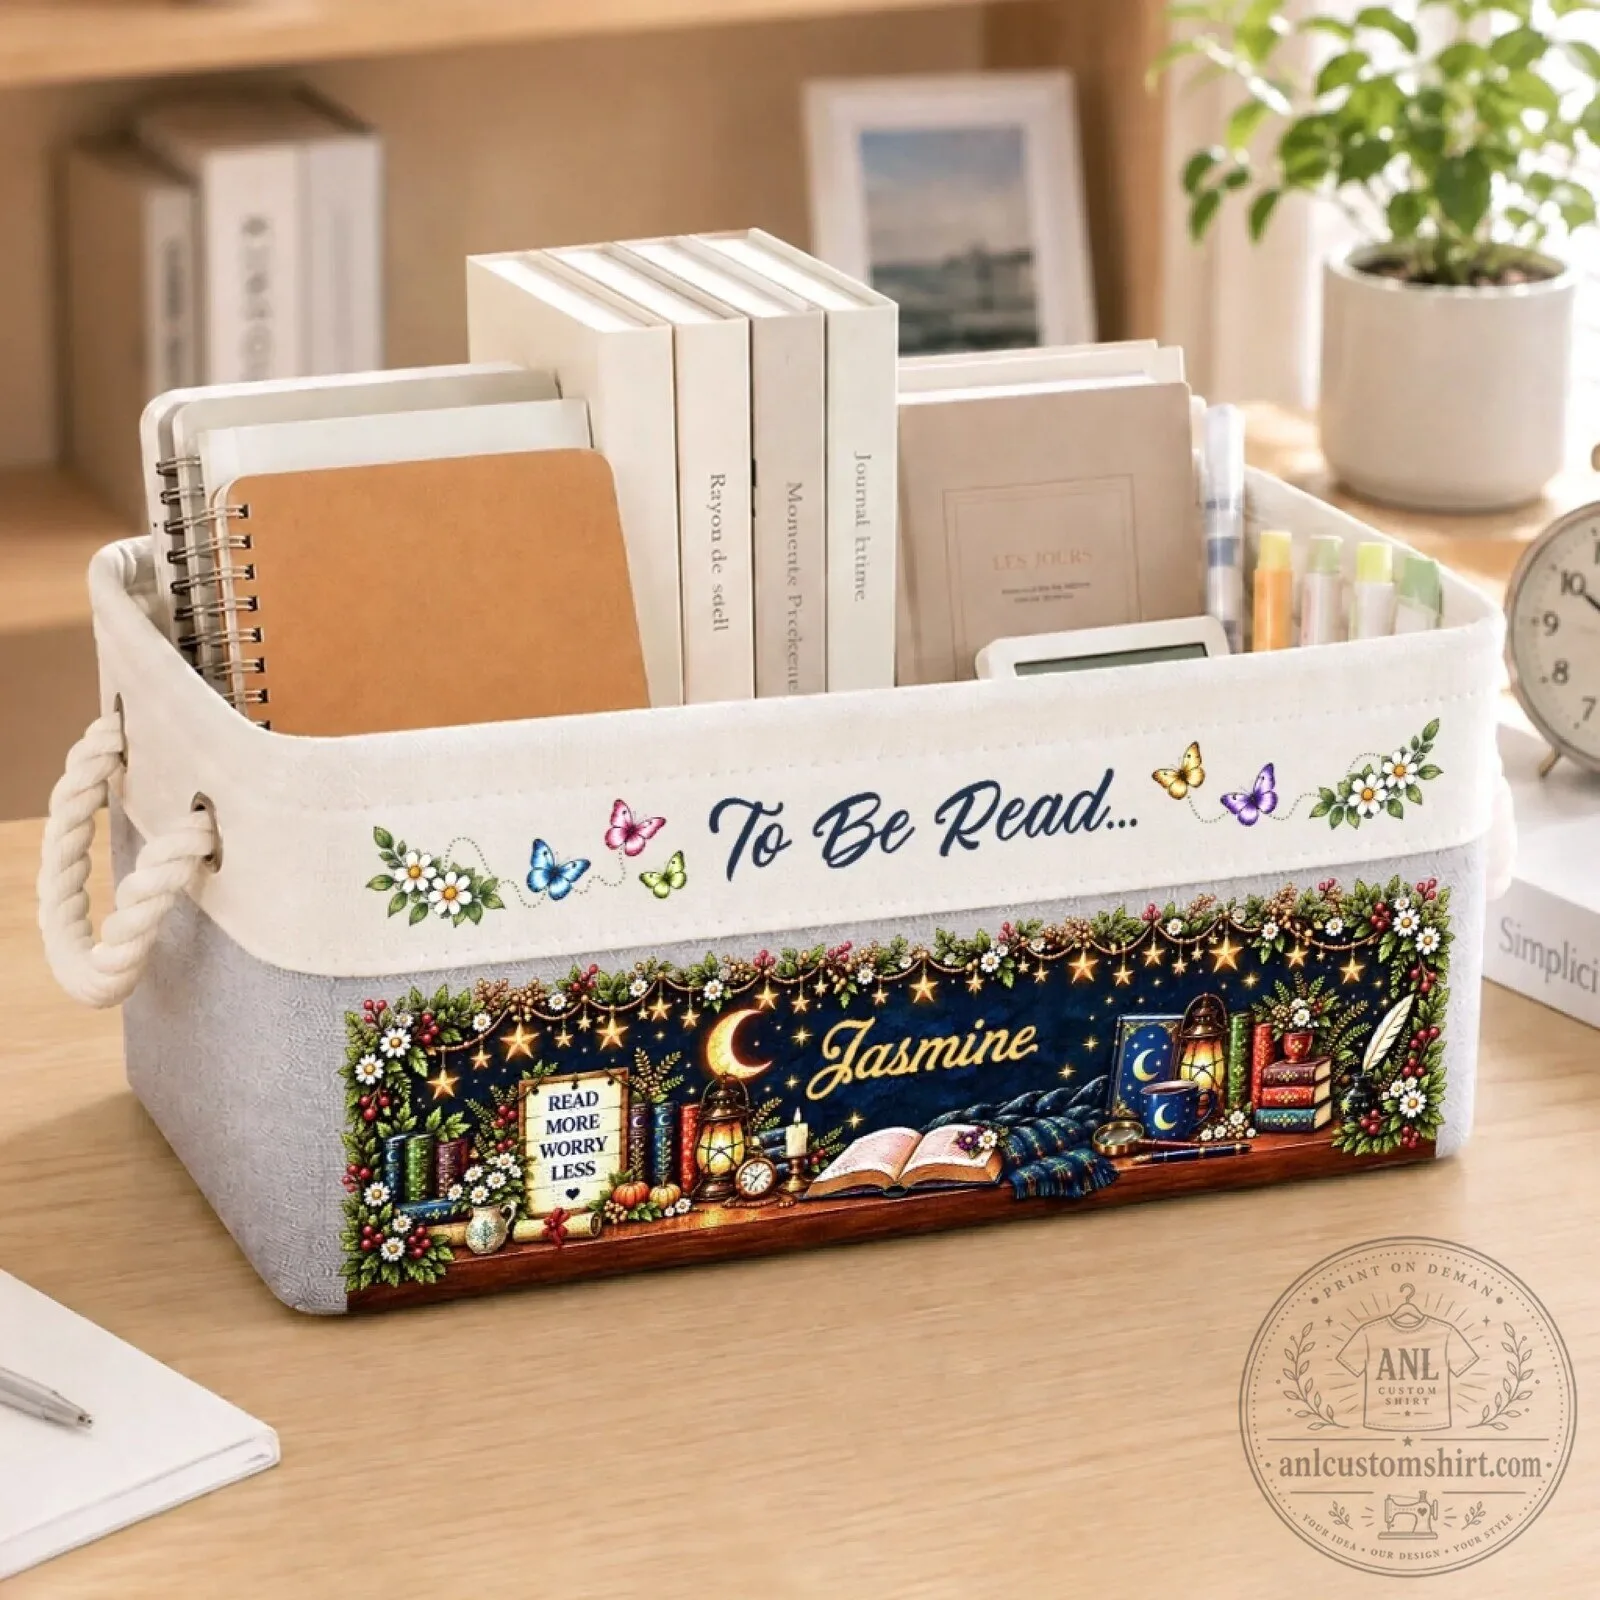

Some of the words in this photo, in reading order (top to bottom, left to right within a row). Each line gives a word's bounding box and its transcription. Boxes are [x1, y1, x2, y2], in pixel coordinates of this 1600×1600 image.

[854, 451, 872, 527] Journal
[706, 473, 727, 542] Rayon
[712, 549, 727, 573] de
[992, 552, 1028, 571] LES
[1560, 569, 1586, 596] 10
[1543, 611, 1559, 636] 9
[1552, 660, 1569, 685] 8
[1582, 697, 1597, 721] 7
[709, 797, 792, 881] To
[812, 792, 915, 869] Be
[935, 768, 1138, 857] Read...
[806, 1016, 1038, 1100] Jasmine
[548, 1091, 599, 1111] READ
[546, 1114, 600, 1135] MORE
[539, 1136, 608, 1159] WORRY
[551, 1161, 596, 1181] LESS
